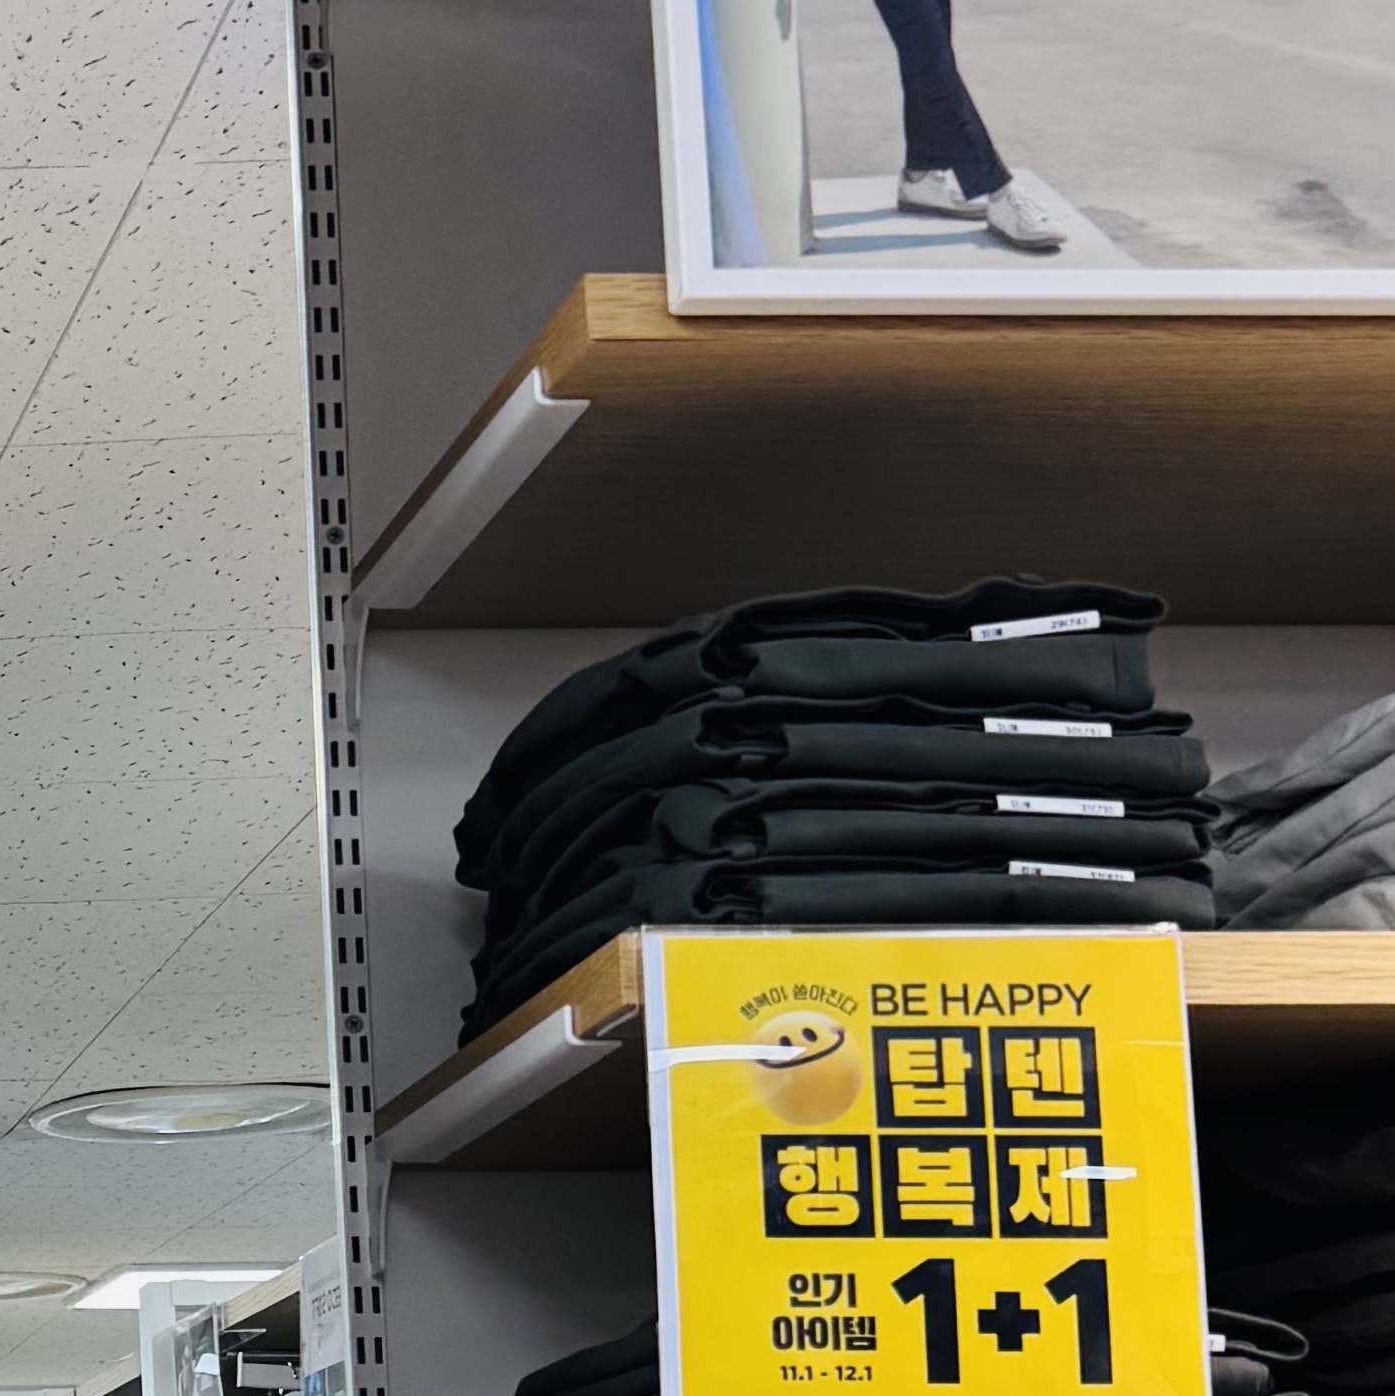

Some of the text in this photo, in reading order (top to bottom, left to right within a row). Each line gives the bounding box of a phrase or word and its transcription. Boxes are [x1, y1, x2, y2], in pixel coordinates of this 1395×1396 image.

[740, 984, 788, 1020] 행복이
[871, 983, 1092, 1016] BE HAPPY
[788, 1273, 858, 1308] 인기
[772, 1316, 877, 1351] 아이템
[891, 1258, 1113, 1384] 1+1
